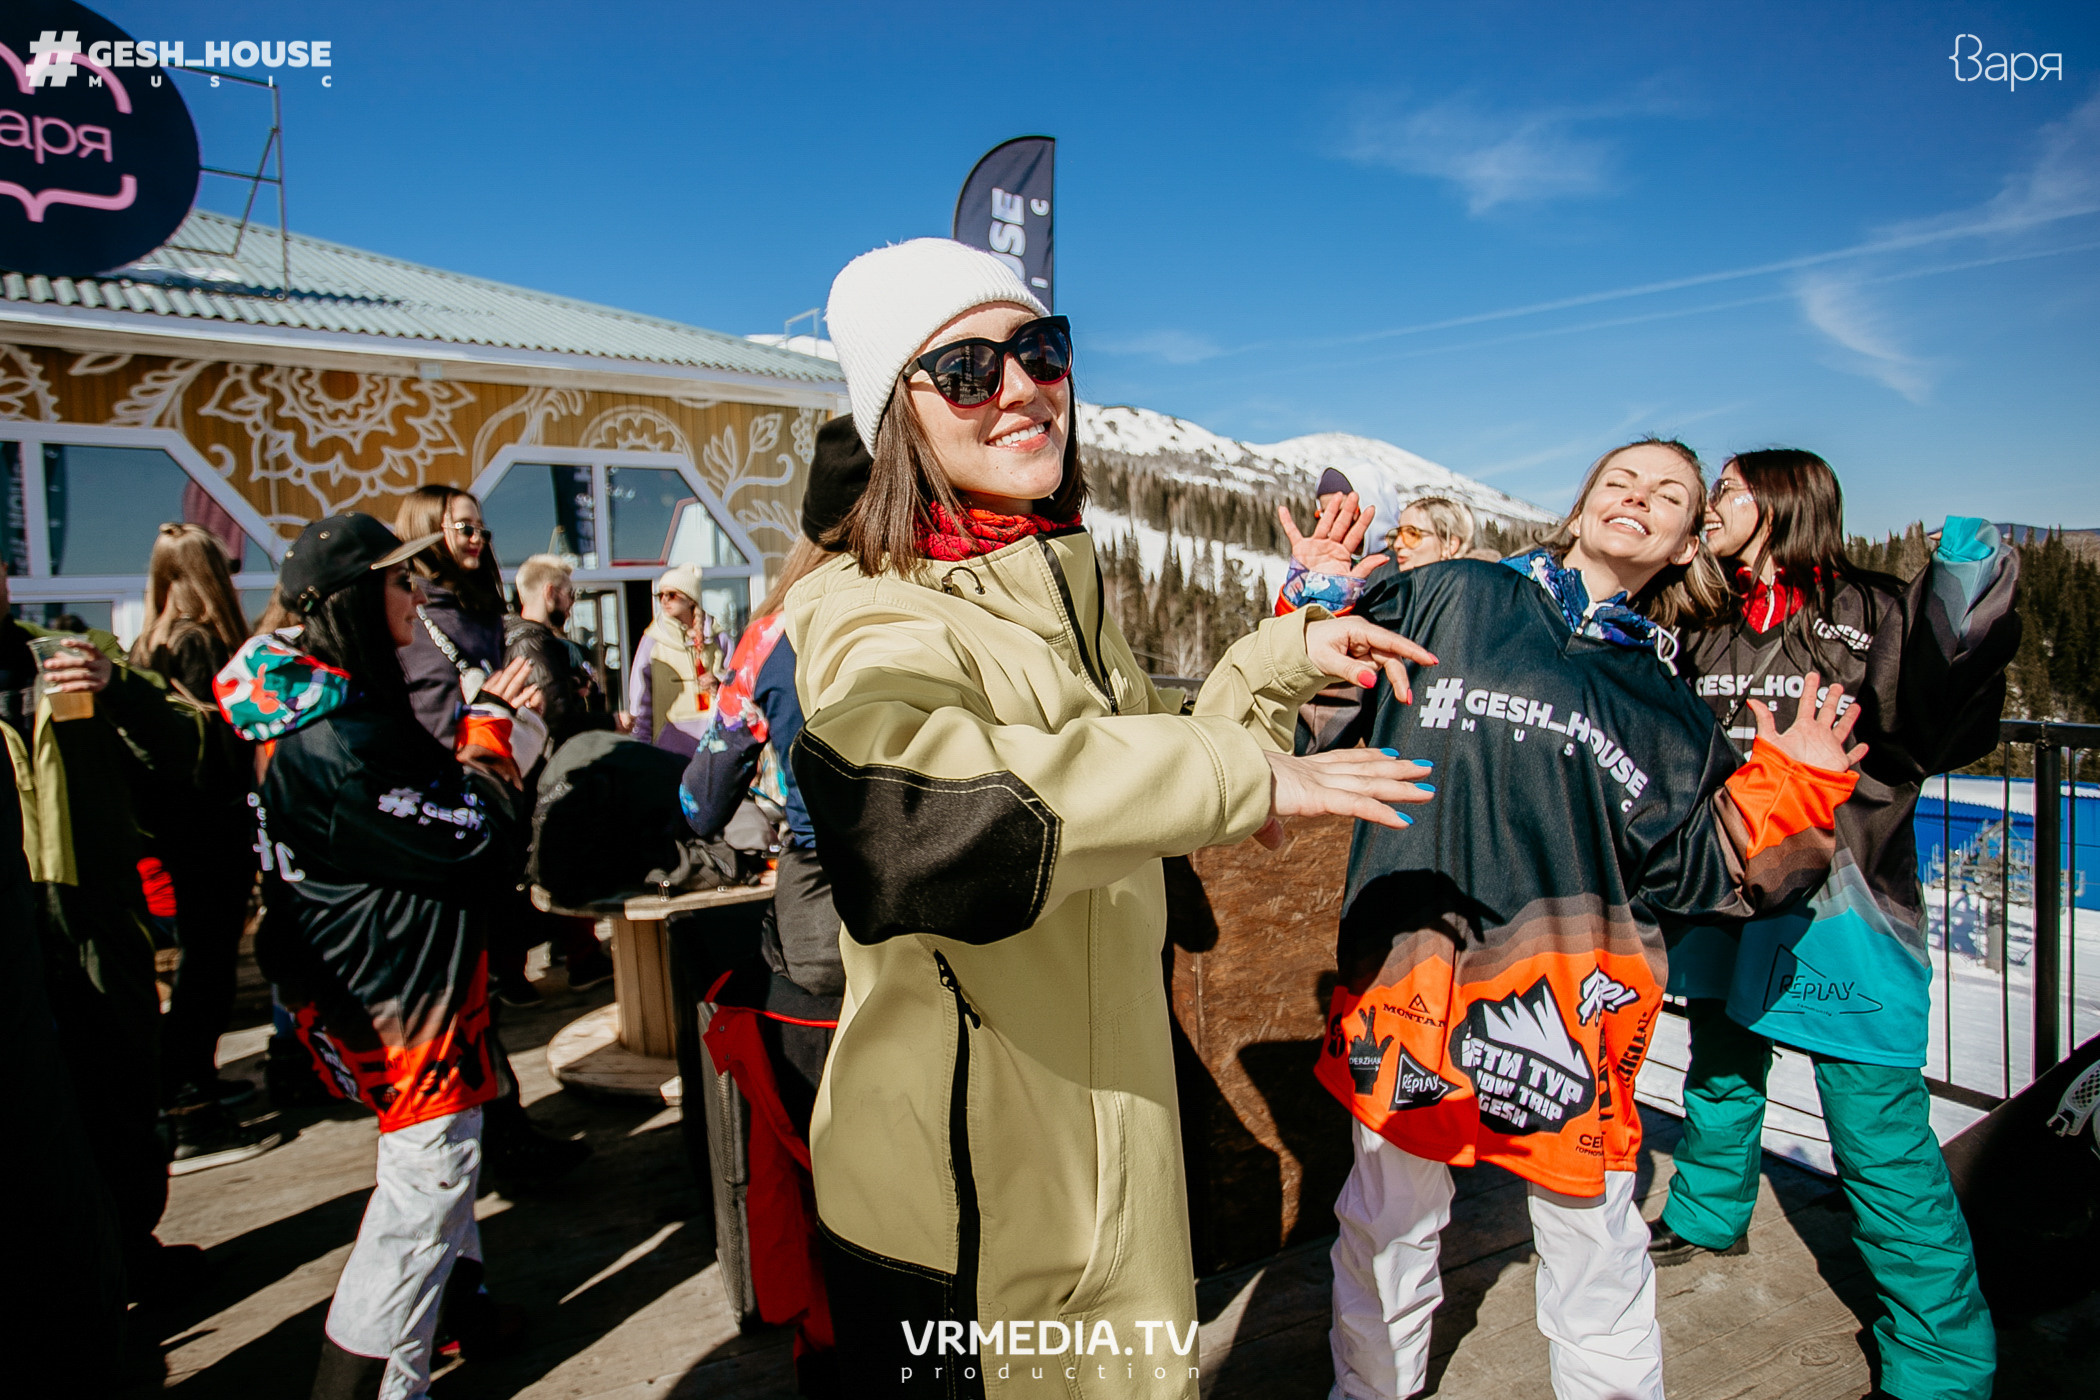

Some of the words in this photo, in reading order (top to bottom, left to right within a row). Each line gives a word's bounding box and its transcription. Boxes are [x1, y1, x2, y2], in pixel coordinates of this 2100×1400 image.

[1460, 717, 1633, 813] MUSC
[1779, 974, 1856, 1001] REPLAY
[1401, 1072, 1440, 1095] REPLAY
